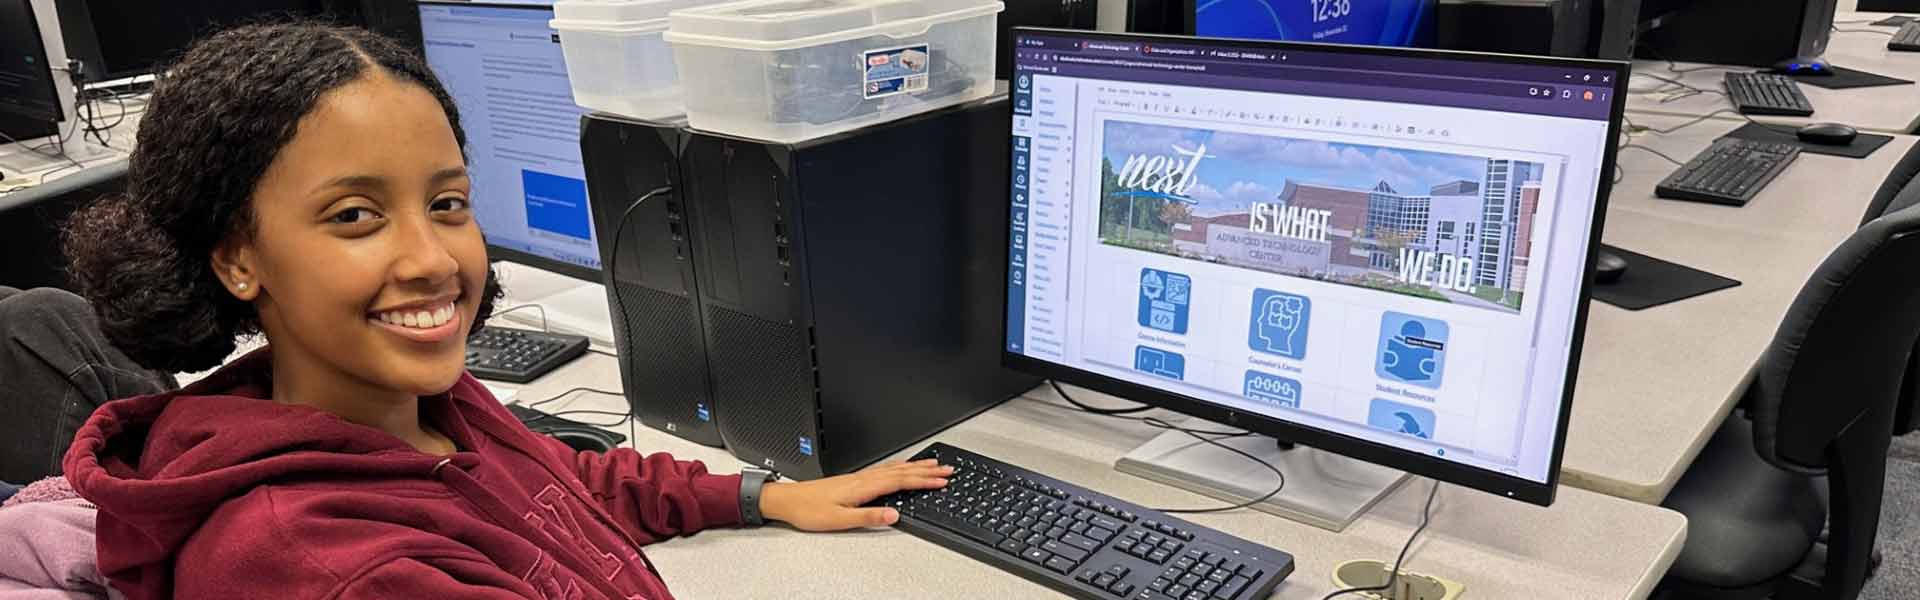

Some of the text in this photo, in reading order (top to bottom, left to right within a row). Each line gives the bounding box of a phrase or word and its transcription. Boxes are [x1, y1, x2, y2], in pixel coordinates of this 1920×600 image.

[1117, 143, 1216, 196] next
[1249, 201, 1331, 242] IS WHAT
[1400, 247, 1476, 294] WE DO.
